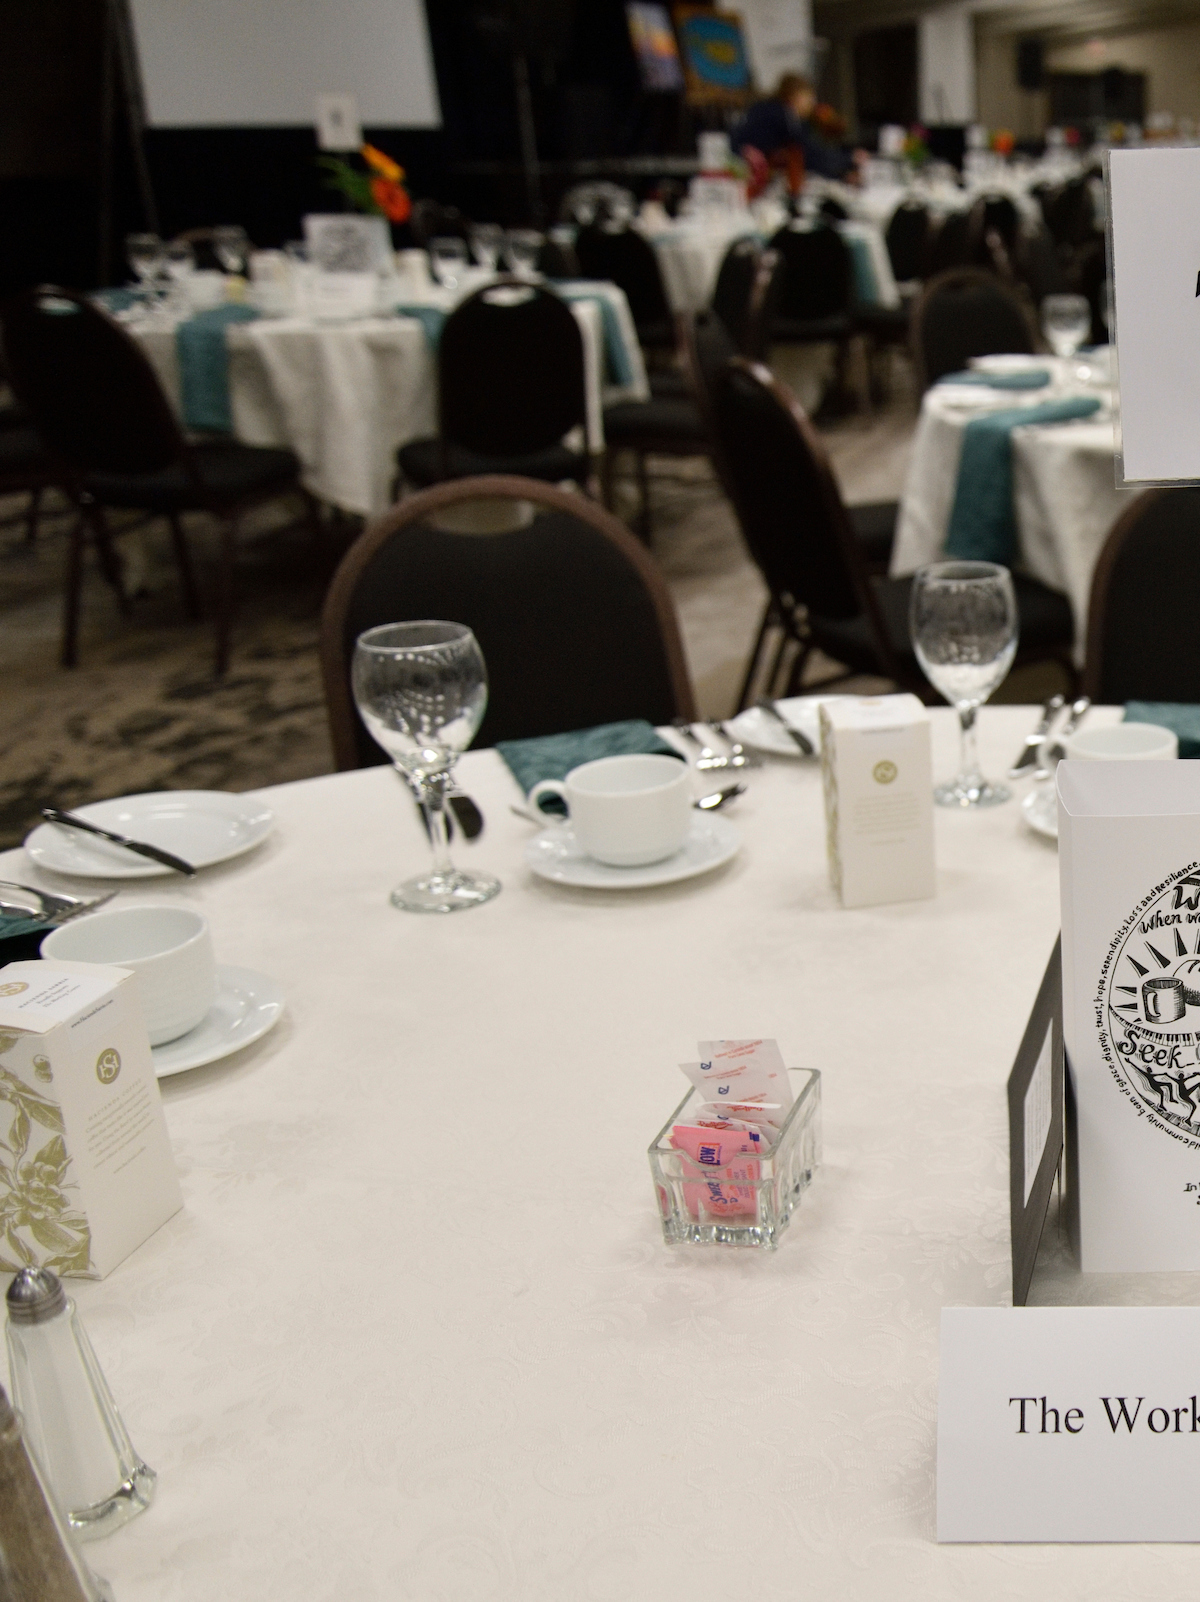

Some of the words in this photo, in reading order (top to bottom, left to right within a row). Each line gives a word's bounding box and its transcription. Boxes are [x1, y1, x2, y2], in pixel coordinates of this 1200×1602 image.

[1142, 889, 1157, 907] and
[1117, 1029, 1185, 1068] Seek
[1146, 1113, 1189, 1144] community
[1183, 1182, 1198, 1193] In
[1008, 1396, 1085, 1434] The
